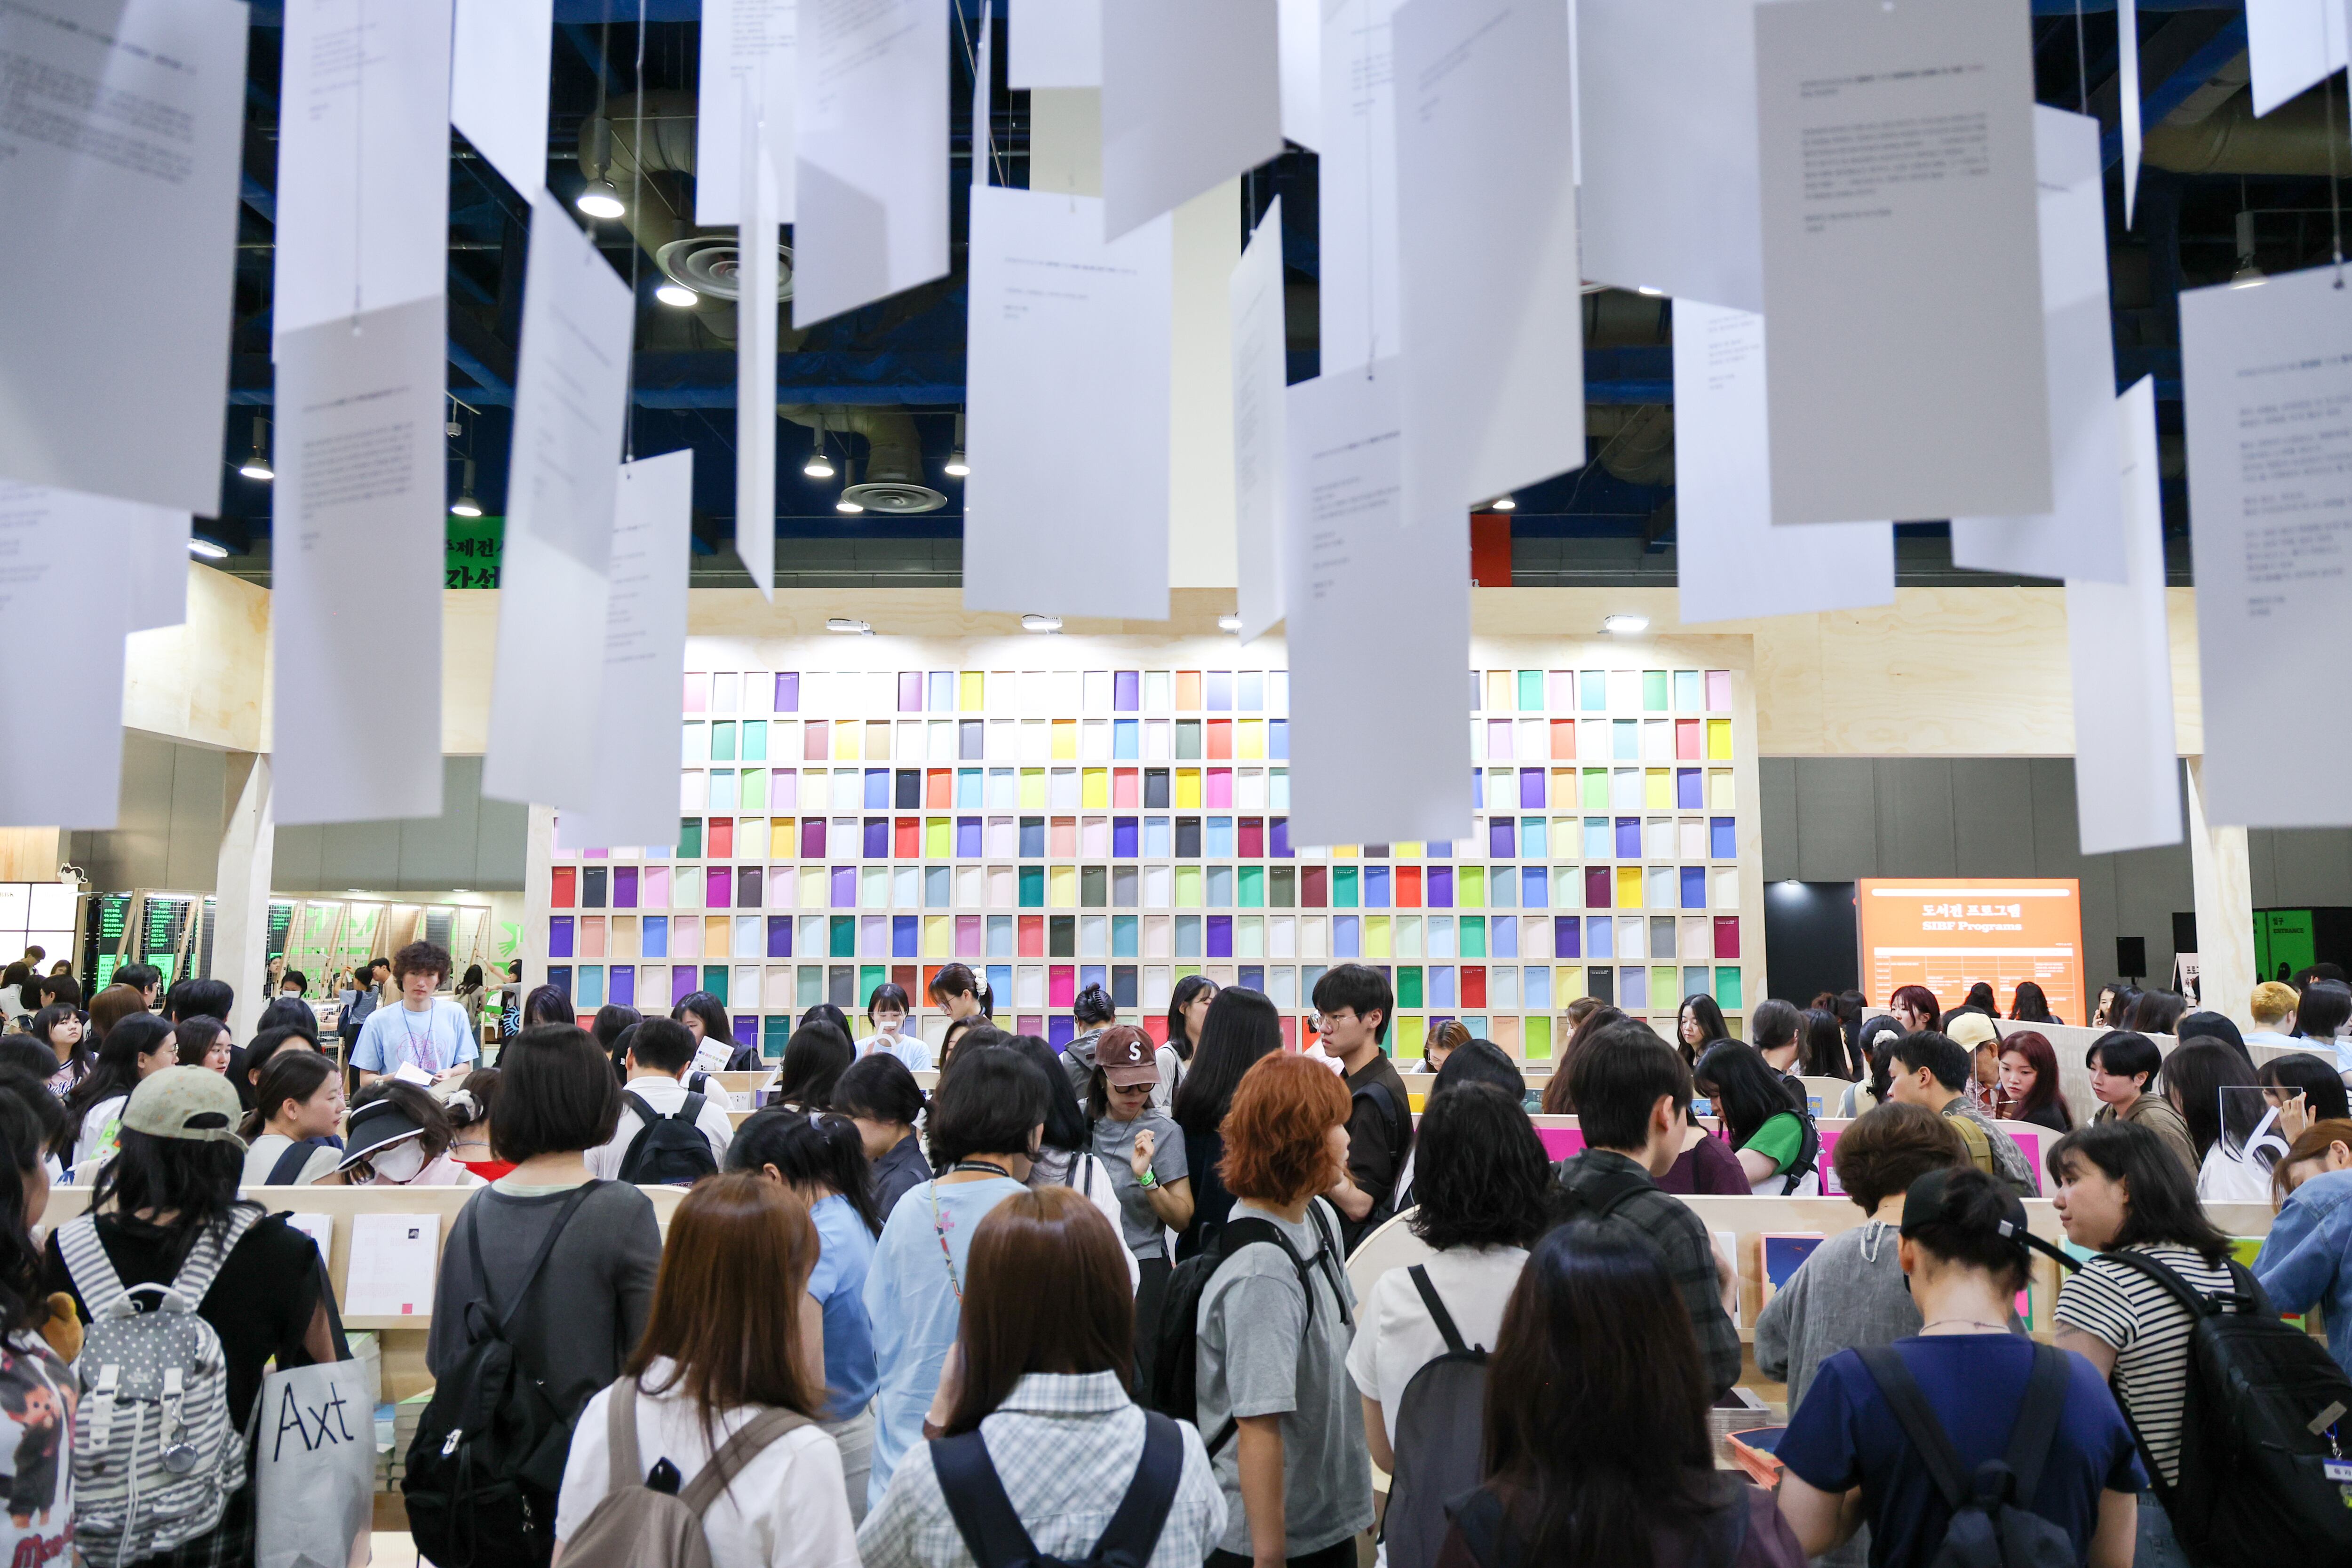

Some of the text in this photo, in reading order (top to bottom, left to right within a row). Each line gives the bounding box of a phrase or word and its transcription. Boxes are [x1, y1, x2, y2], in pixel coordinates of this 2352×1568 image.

[445, 538, 504, 557] 제전
[1922, 904, 2020, 918] 도서전 프로그램
[1923, 921, 2022, 932] SIBF Programs
[874, 1021, 897, 1054] 5
[1128, 1041, 1141, 1061] S
[2242, 1105, 2291, 1182] 6
[274, 1382, 354, 1462] Axt
